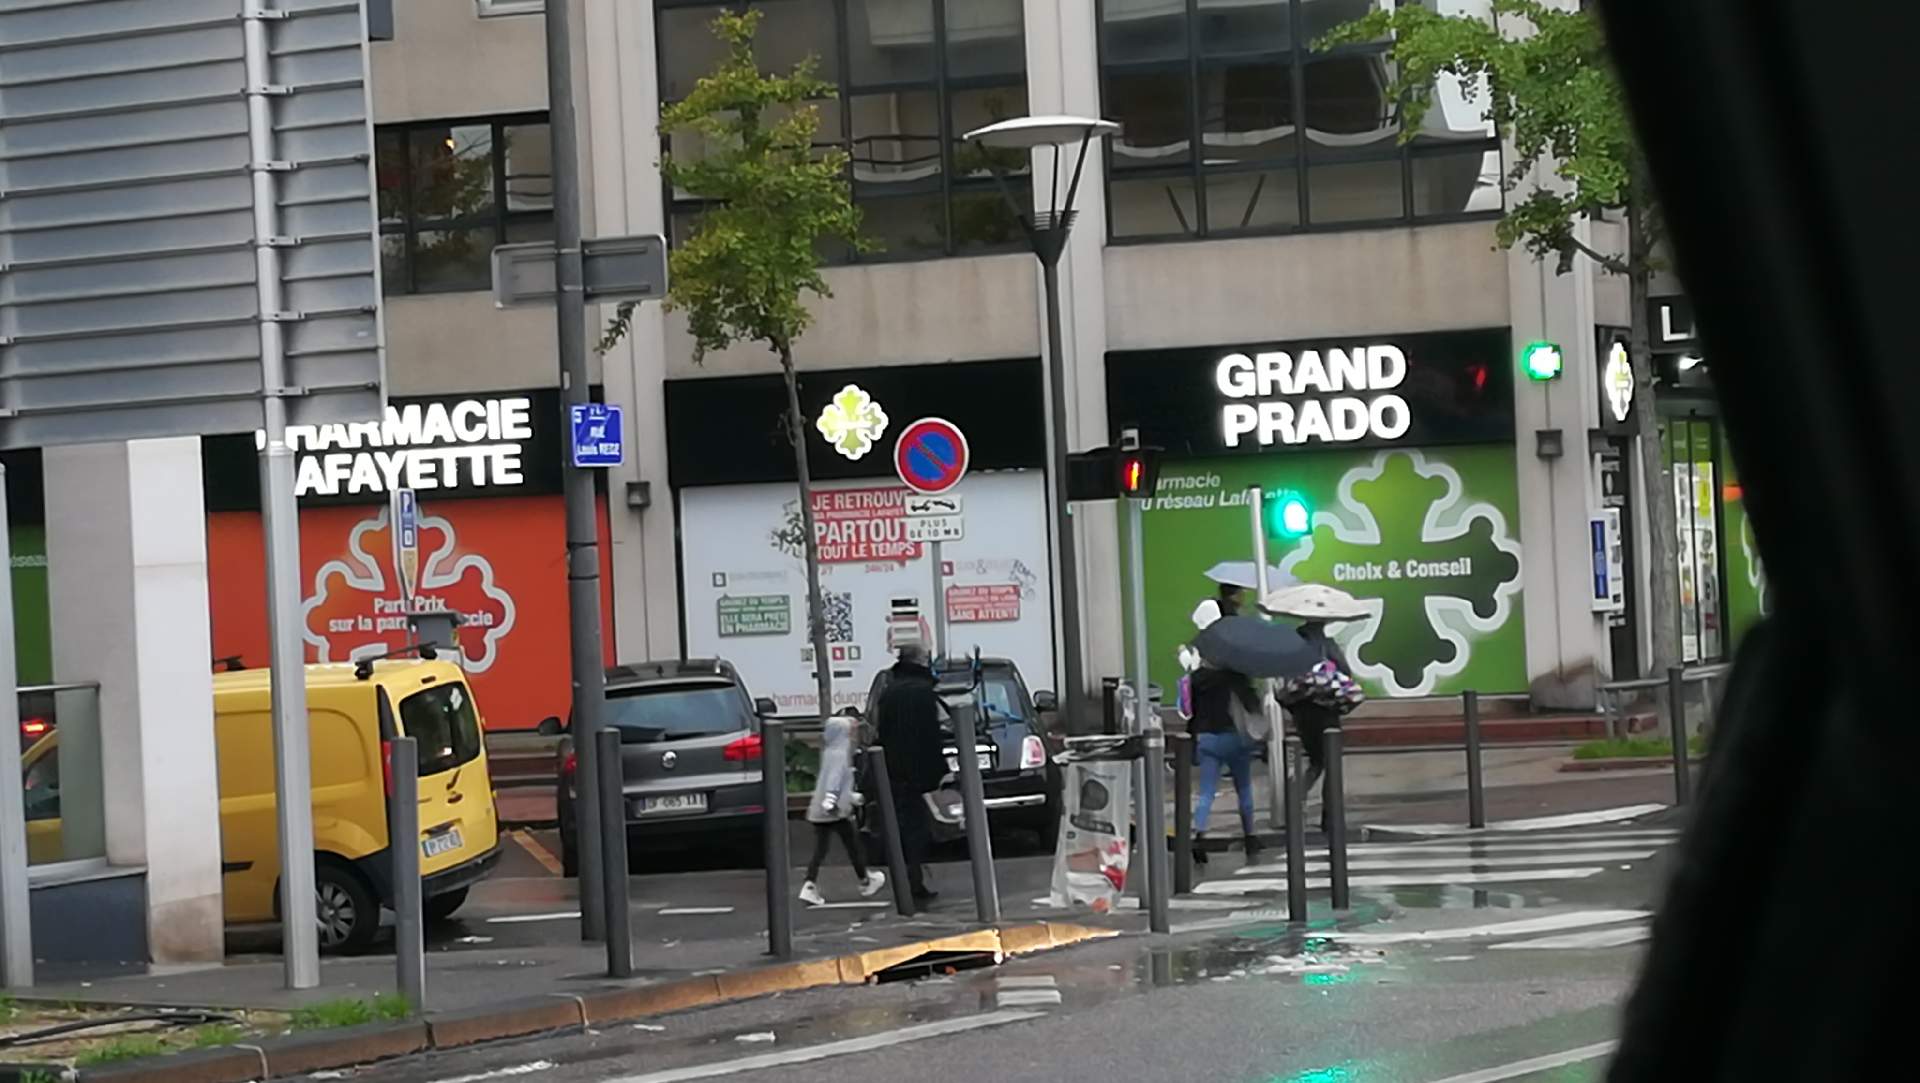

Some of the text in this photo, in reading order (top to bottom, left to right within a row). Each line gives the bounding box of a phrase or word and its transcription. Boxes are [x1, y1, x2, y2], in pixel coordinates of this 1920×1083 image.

[1216, 345, 1407, 398] GRAND
[255, 399, 532, 450] HARMACIE
[1223, 394, 1411, 447] PRADO
[294, 444, 524, 496] AFAYETTE
[1156, 472, 1221, 490] armacie
[812, 493, 830, 510] JE
[1141, 499, 1151, 511] u
[1156, 491, 1214, 510] réseau
[920, 518, 947, 528] PLUS
[817, 542, 915, 559] TOUT LE TEMPS
[1333, 557, 1472, 581] Choix & Conseil
[374, 595, 446, 614] Part Prix
[329, 619, 354, 632] sur
[358, 615, 373, 631] la
